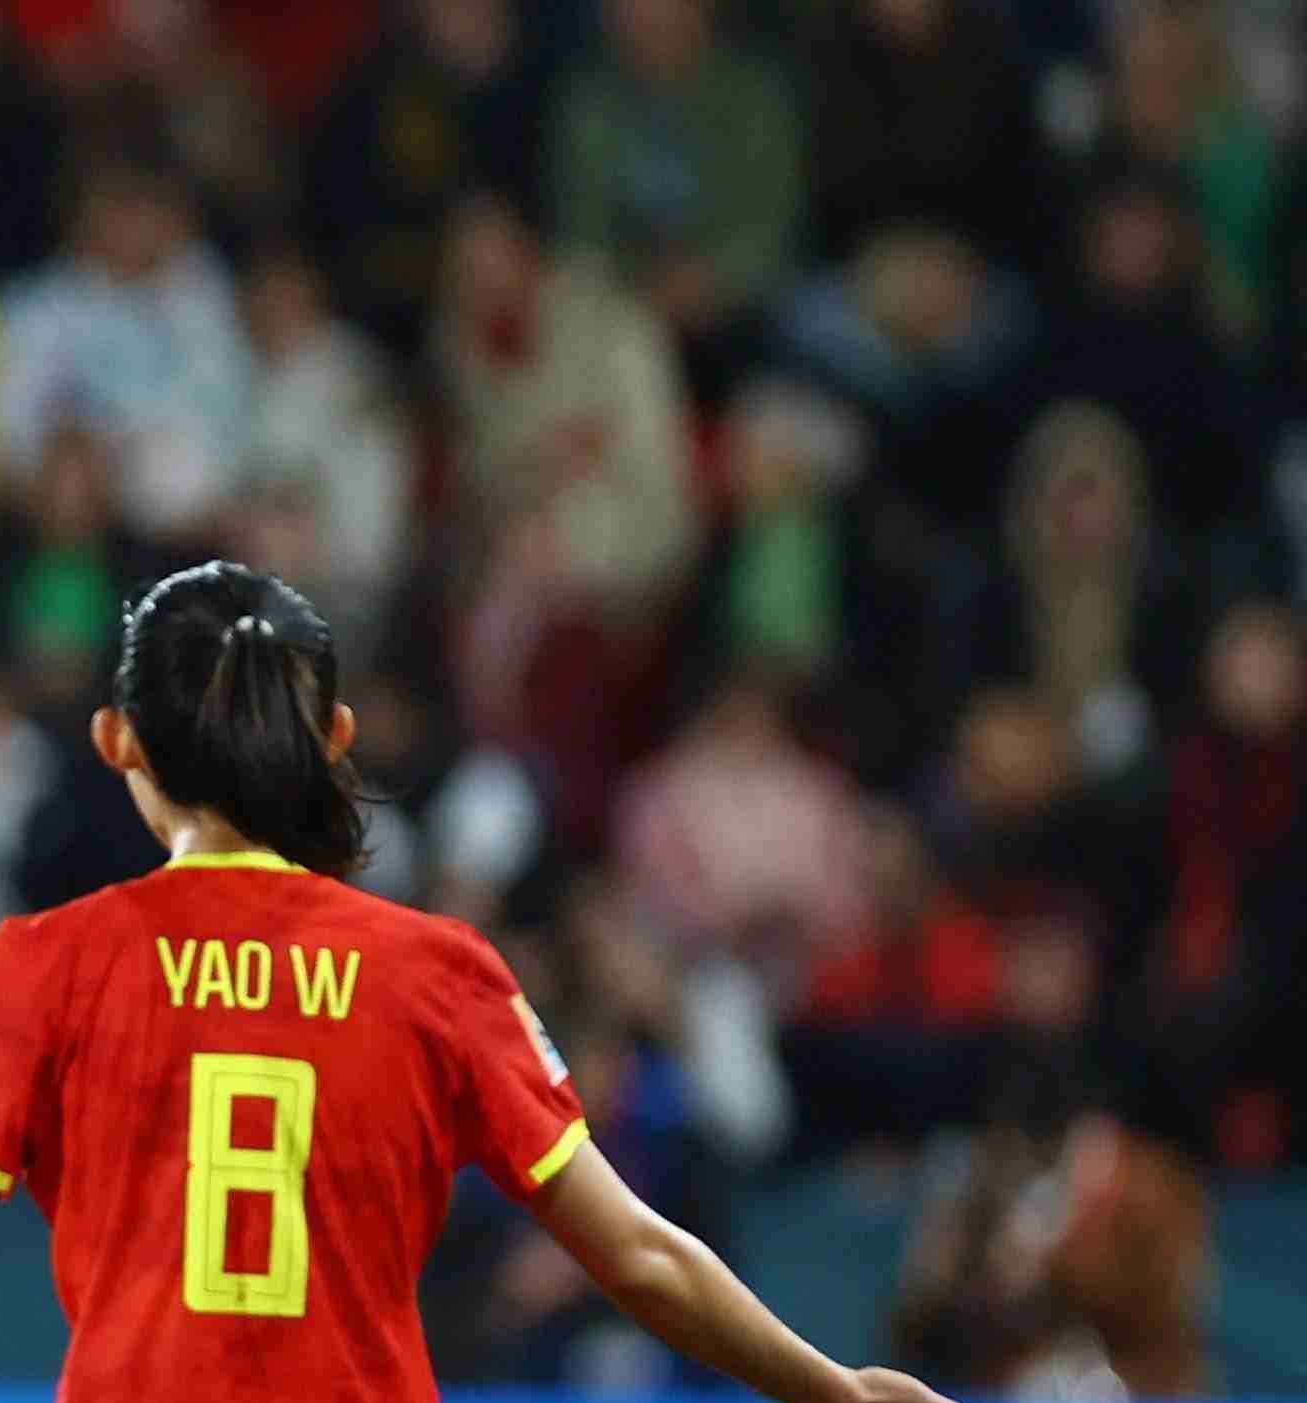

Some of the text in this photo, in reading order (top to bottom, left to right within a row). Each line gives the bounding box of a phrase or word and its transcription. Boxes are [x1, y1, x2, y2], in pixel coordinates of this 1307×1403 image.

[156, 936, 361, 1020] YAO W
[183, 1052, 317, 1318] 8
